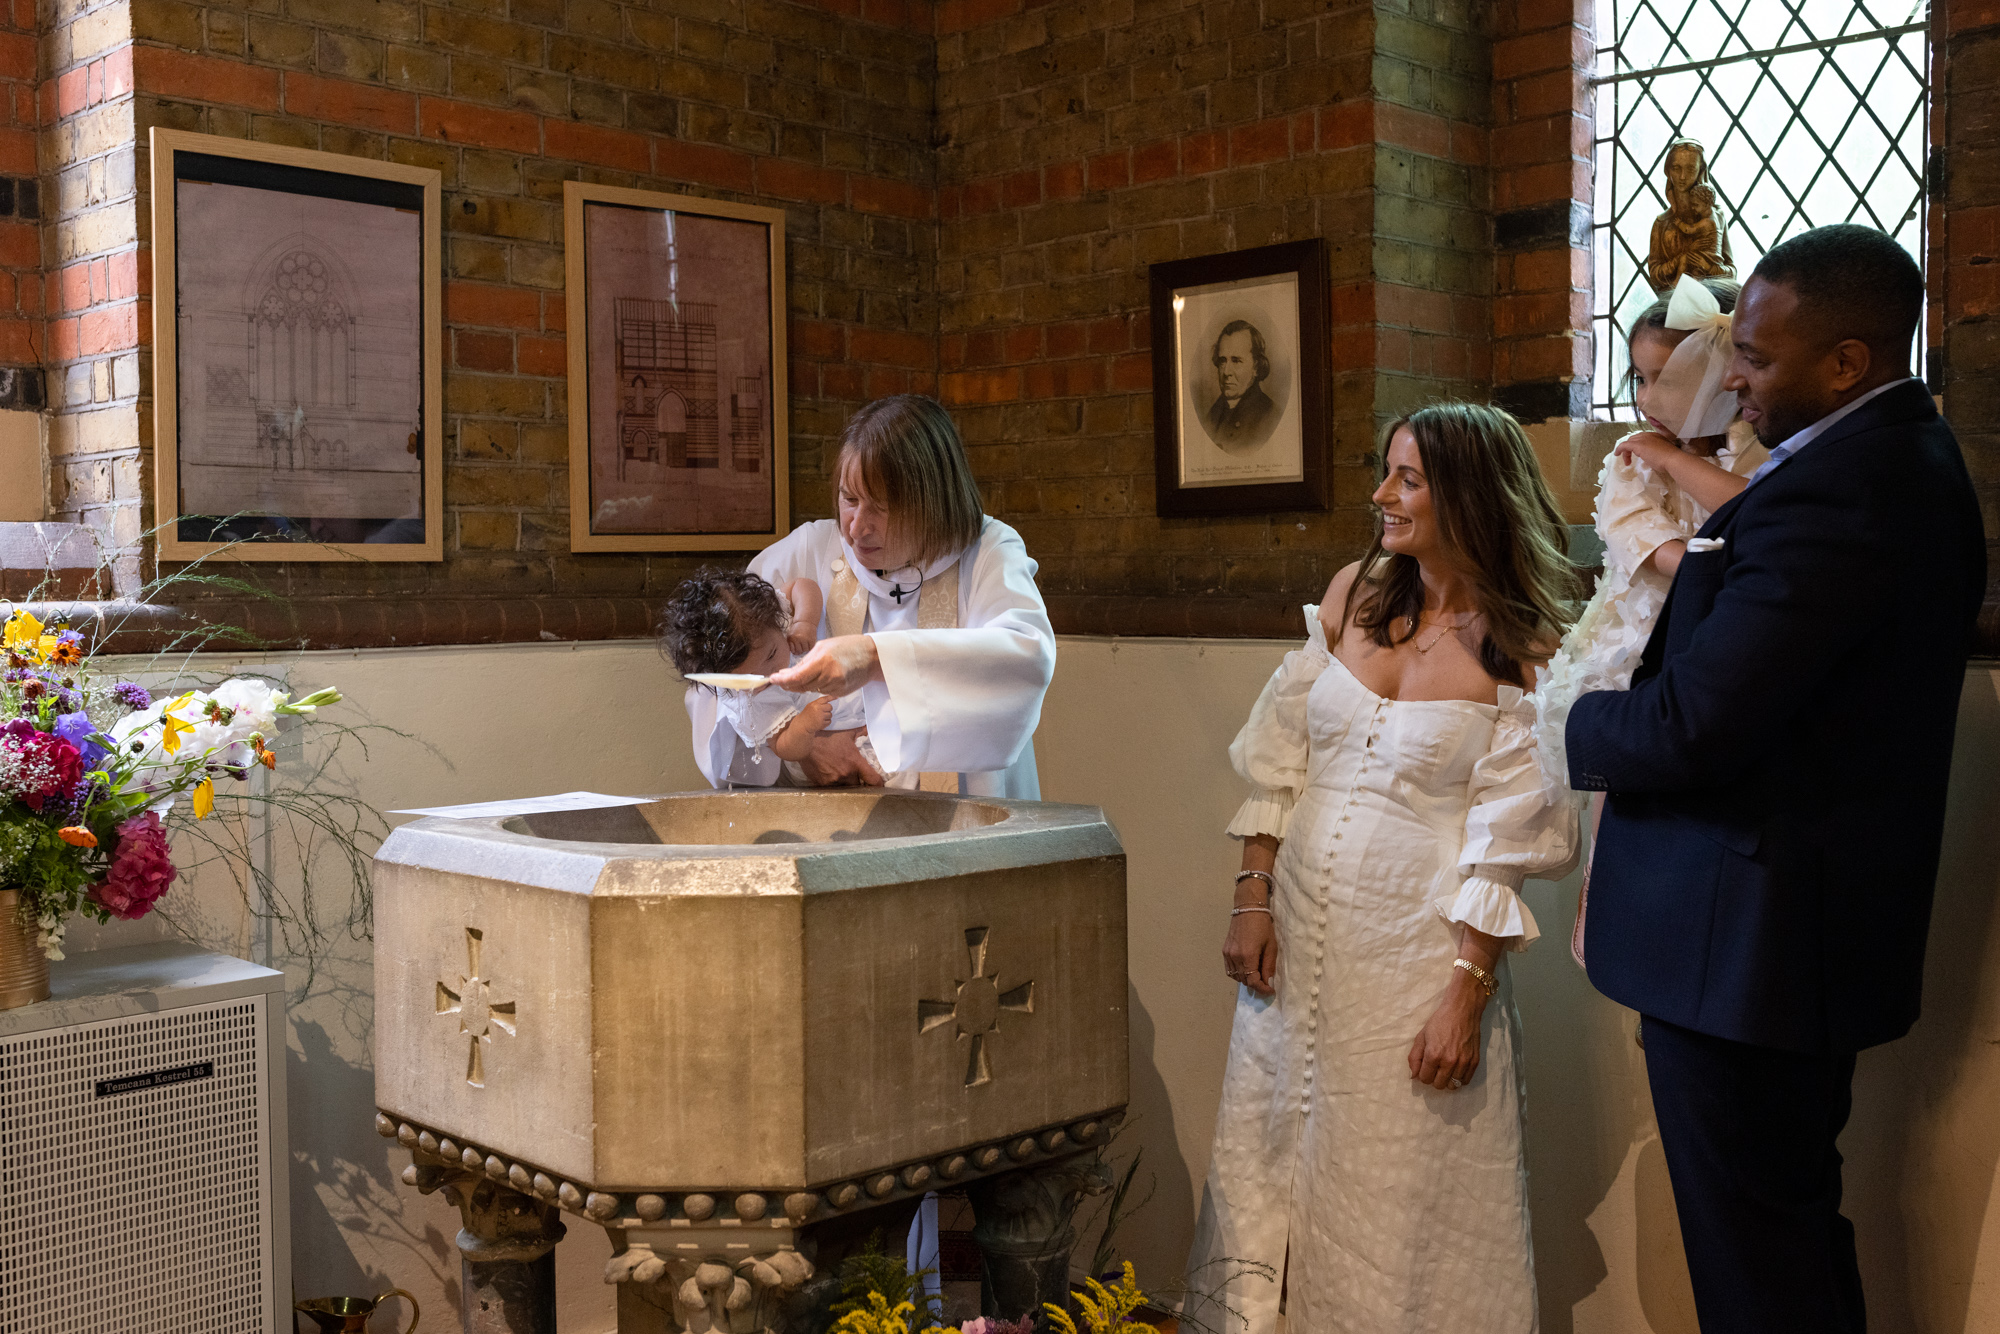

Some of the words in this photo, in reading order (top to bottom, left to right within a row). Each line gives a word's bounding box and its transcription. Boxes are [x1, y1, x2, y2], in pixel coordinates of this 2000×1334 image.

[105, 1079, 151, 1092] Temcana
[154, 1068, 191, 1083] Kestrel
[193, 1066, 204, 1076] 55
